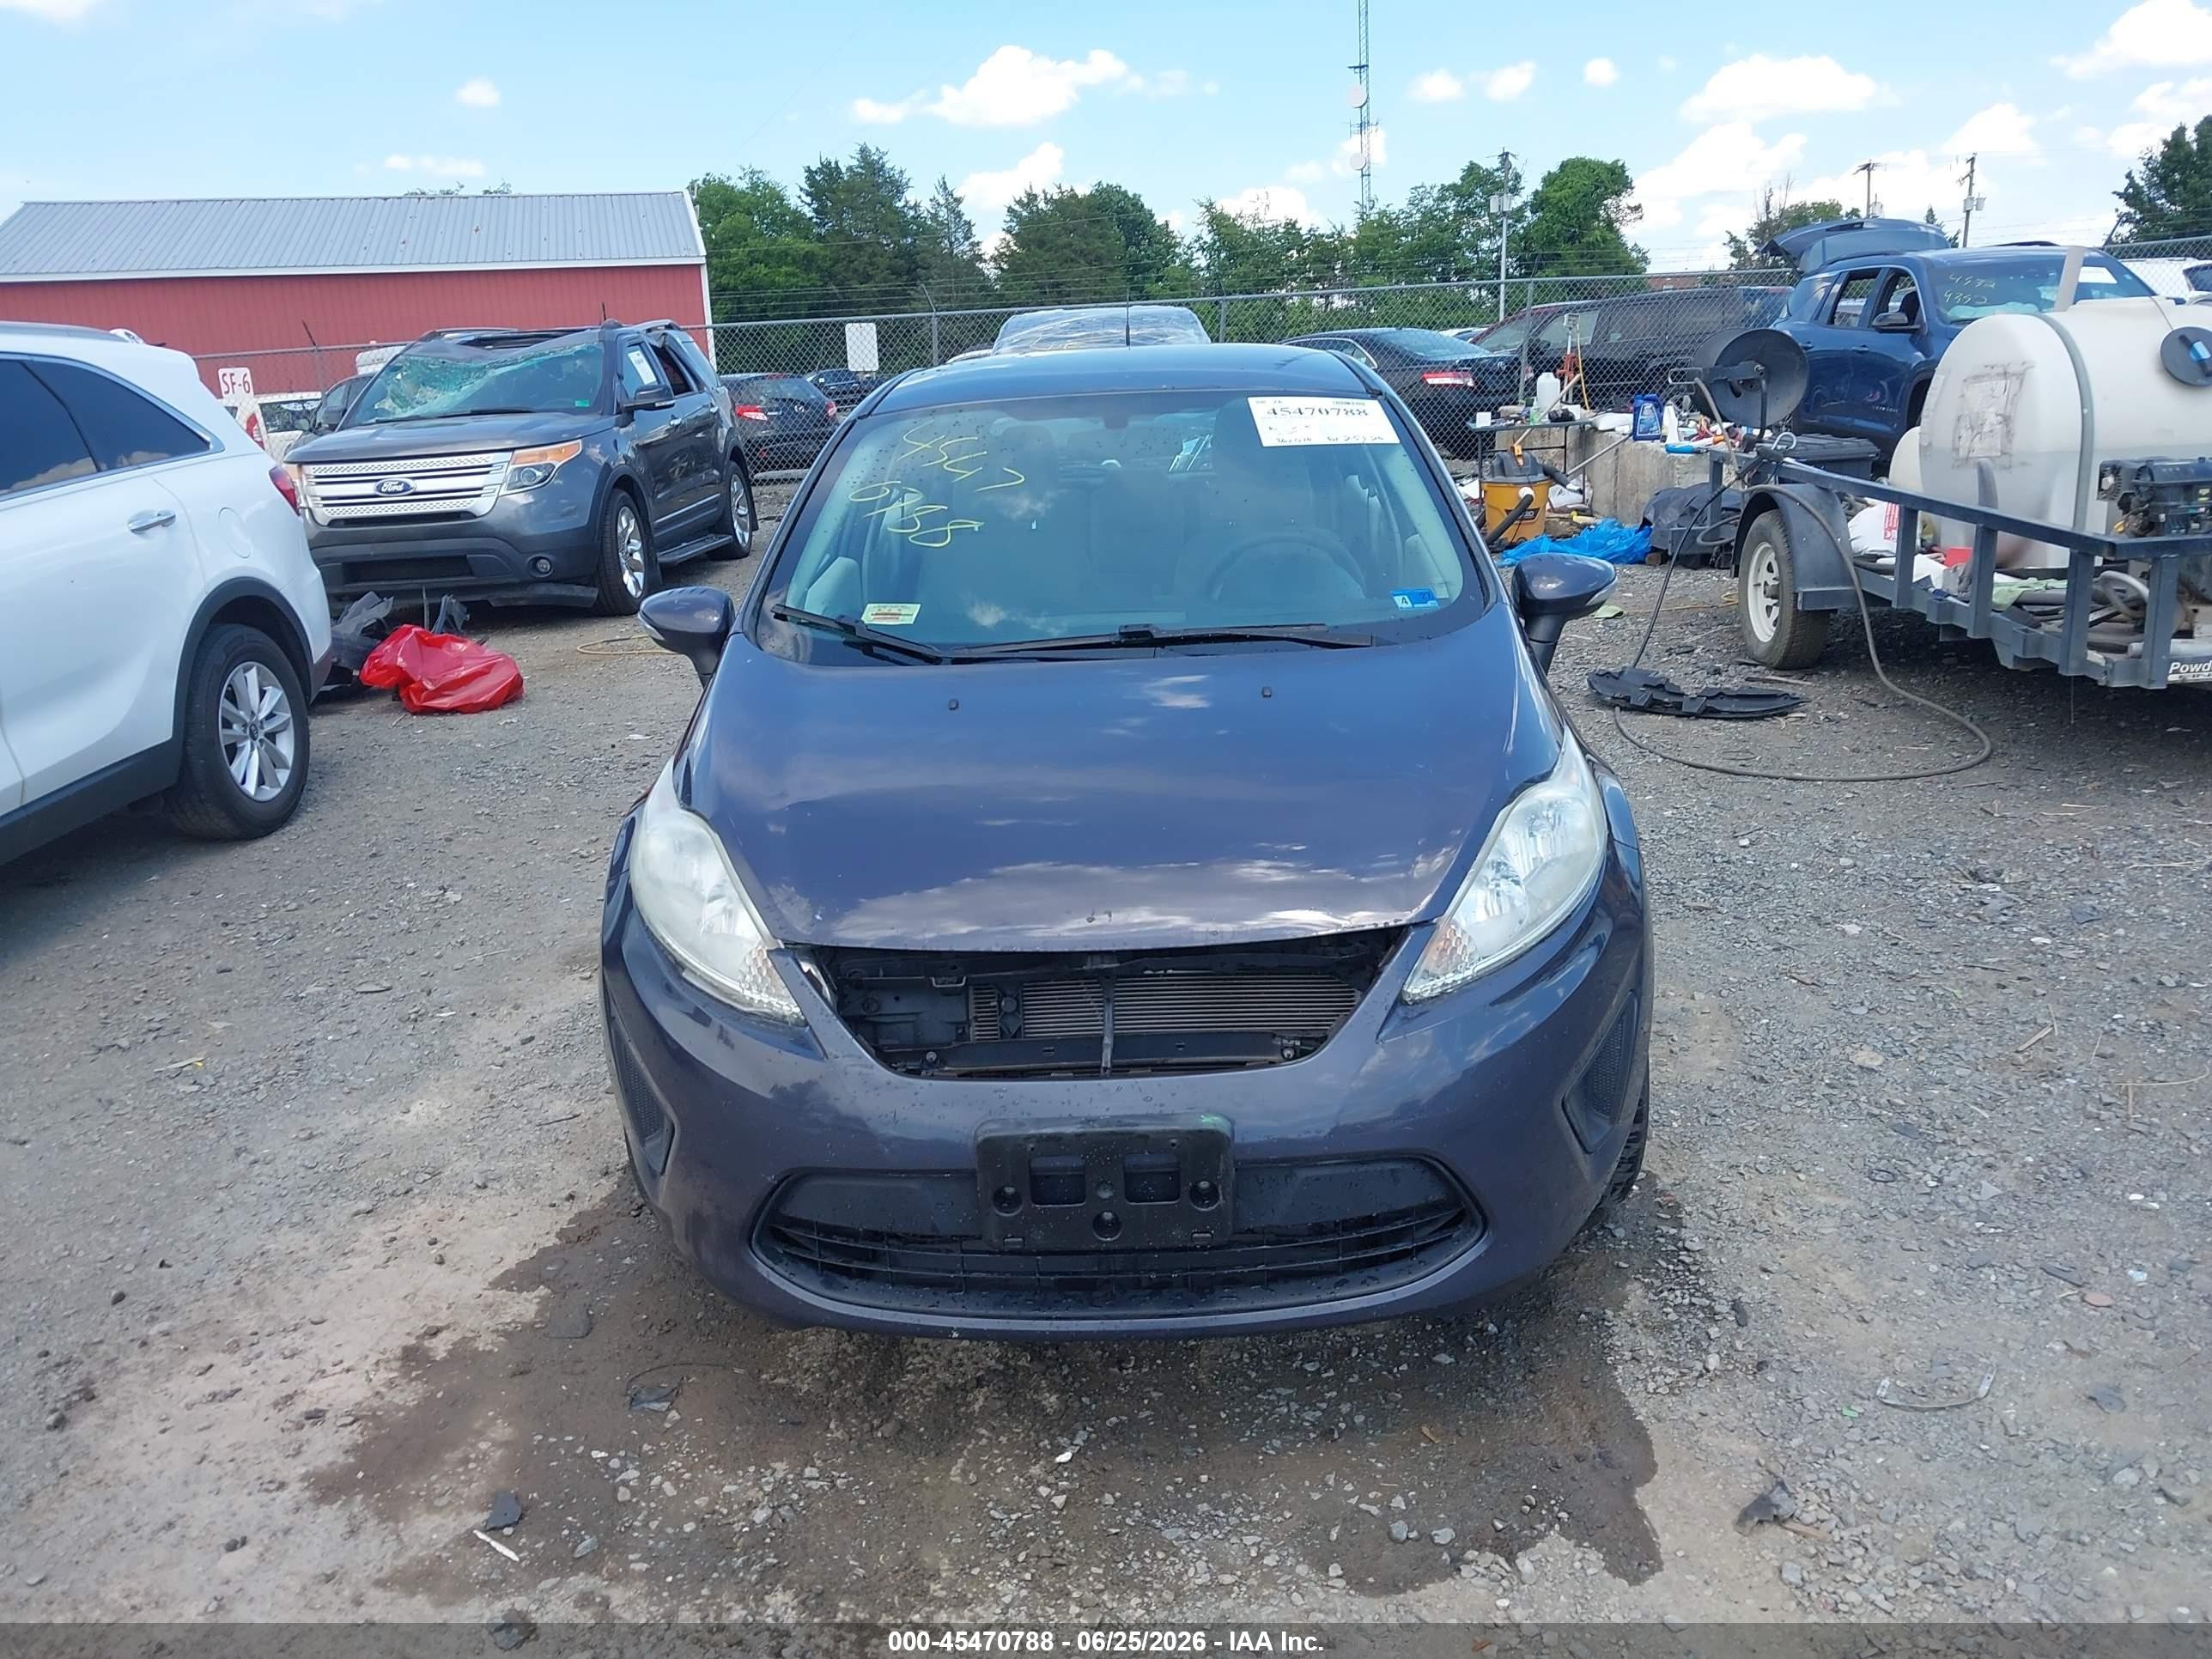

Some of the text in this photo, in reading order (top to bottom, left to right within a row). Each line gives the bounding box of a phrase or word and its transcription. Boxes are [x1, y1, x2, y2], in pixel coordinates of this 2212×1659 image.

[222, 372, 251, 395] SF-6
[1267, 406, 1369, 416] 45470788
[897, 419, 1025, 492] 4547
[380, 480, 404, 493] Ford
